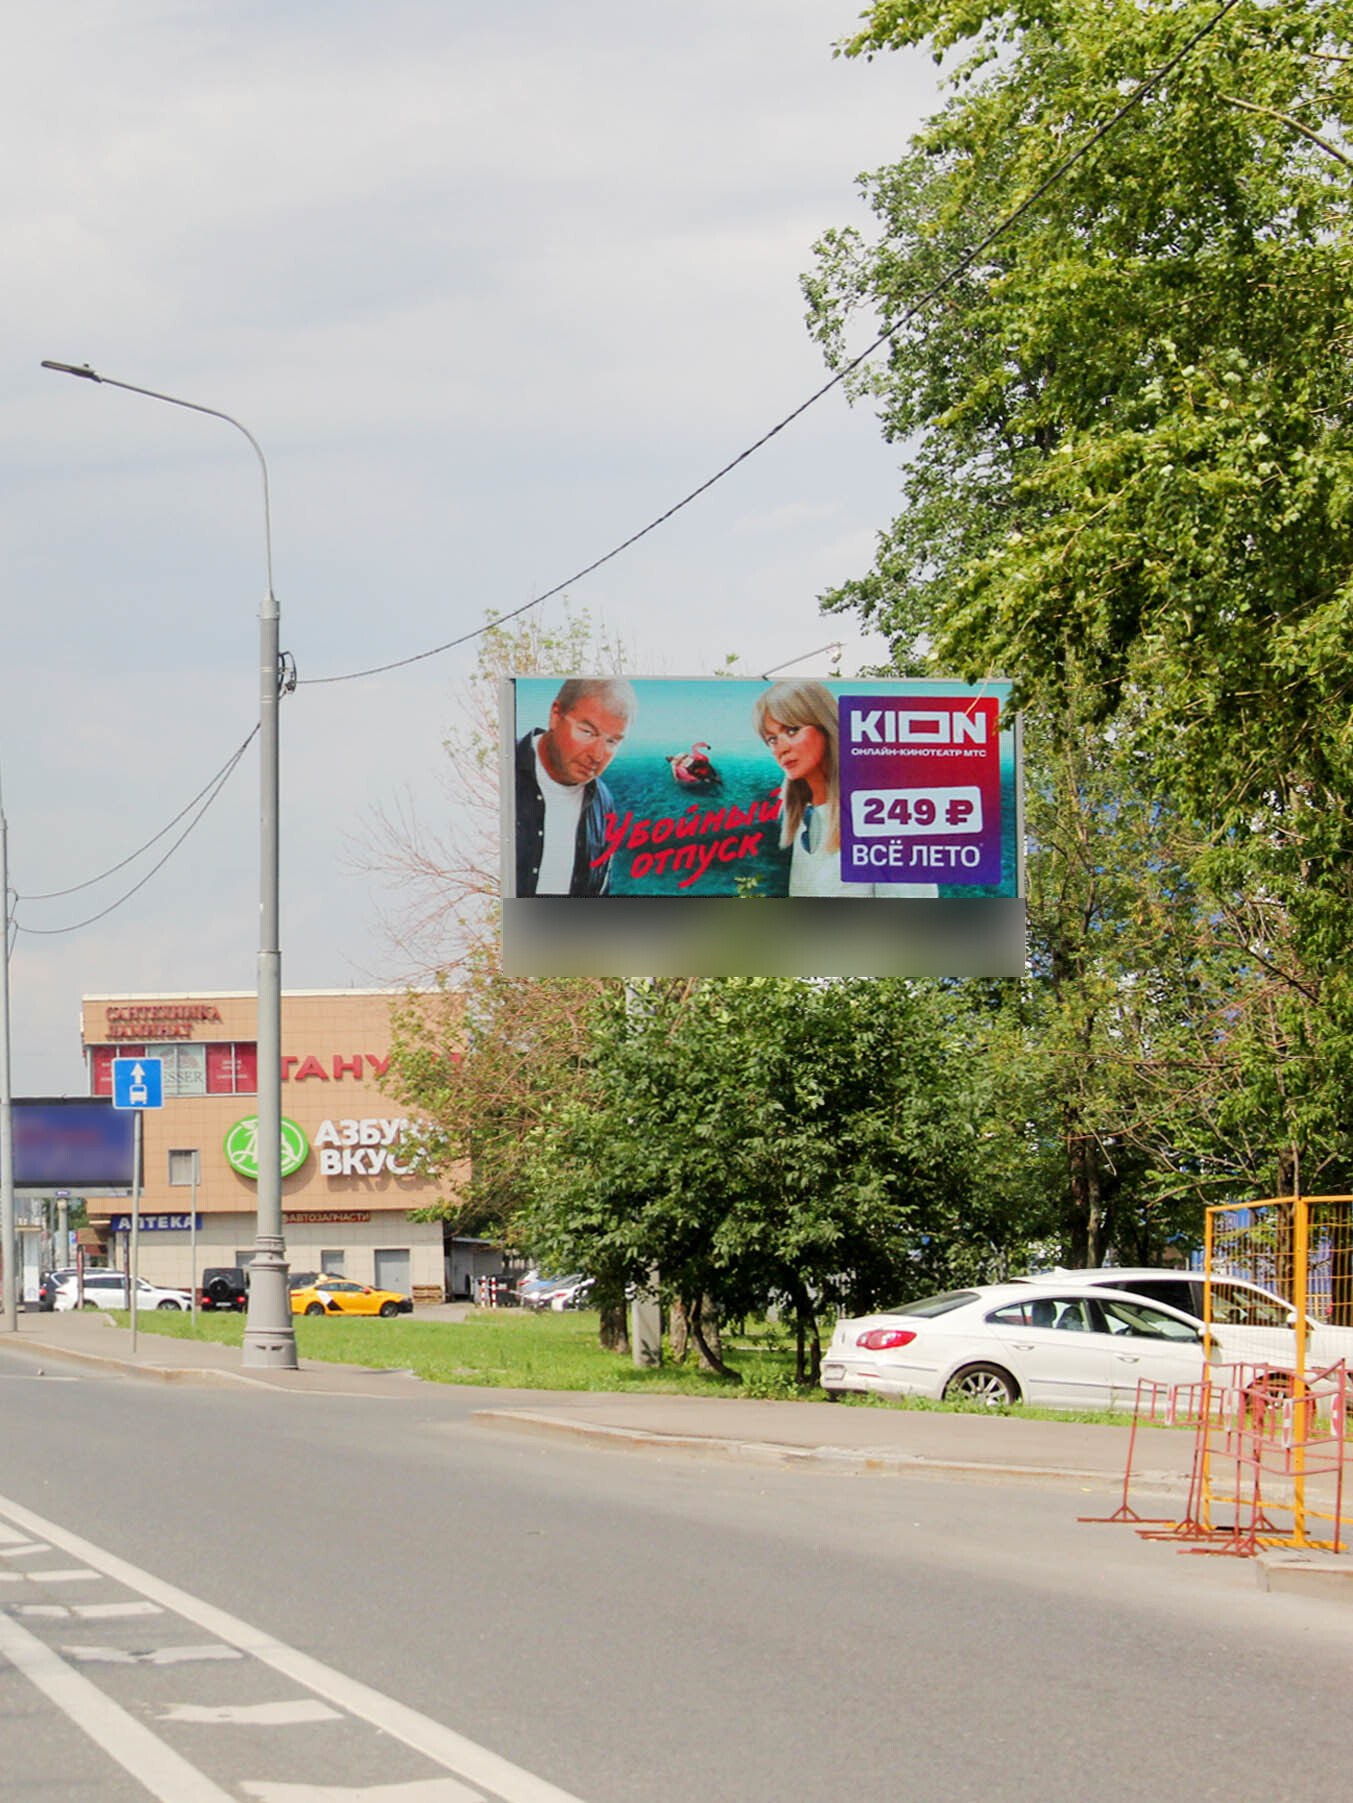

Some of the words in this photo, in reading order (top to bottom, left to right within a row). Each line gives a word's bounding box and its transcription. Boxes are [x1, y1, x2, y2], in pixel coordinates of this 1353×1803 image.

[850, 710, 987, 744] KION
[851, 746, 963, 757] ОНЛАЙН-КИНОТЕАТР
[963, 748, 987, 758] МТС
[863, 797, 936, 826] 249
[851, 839, 904, 867] ВСЁ
